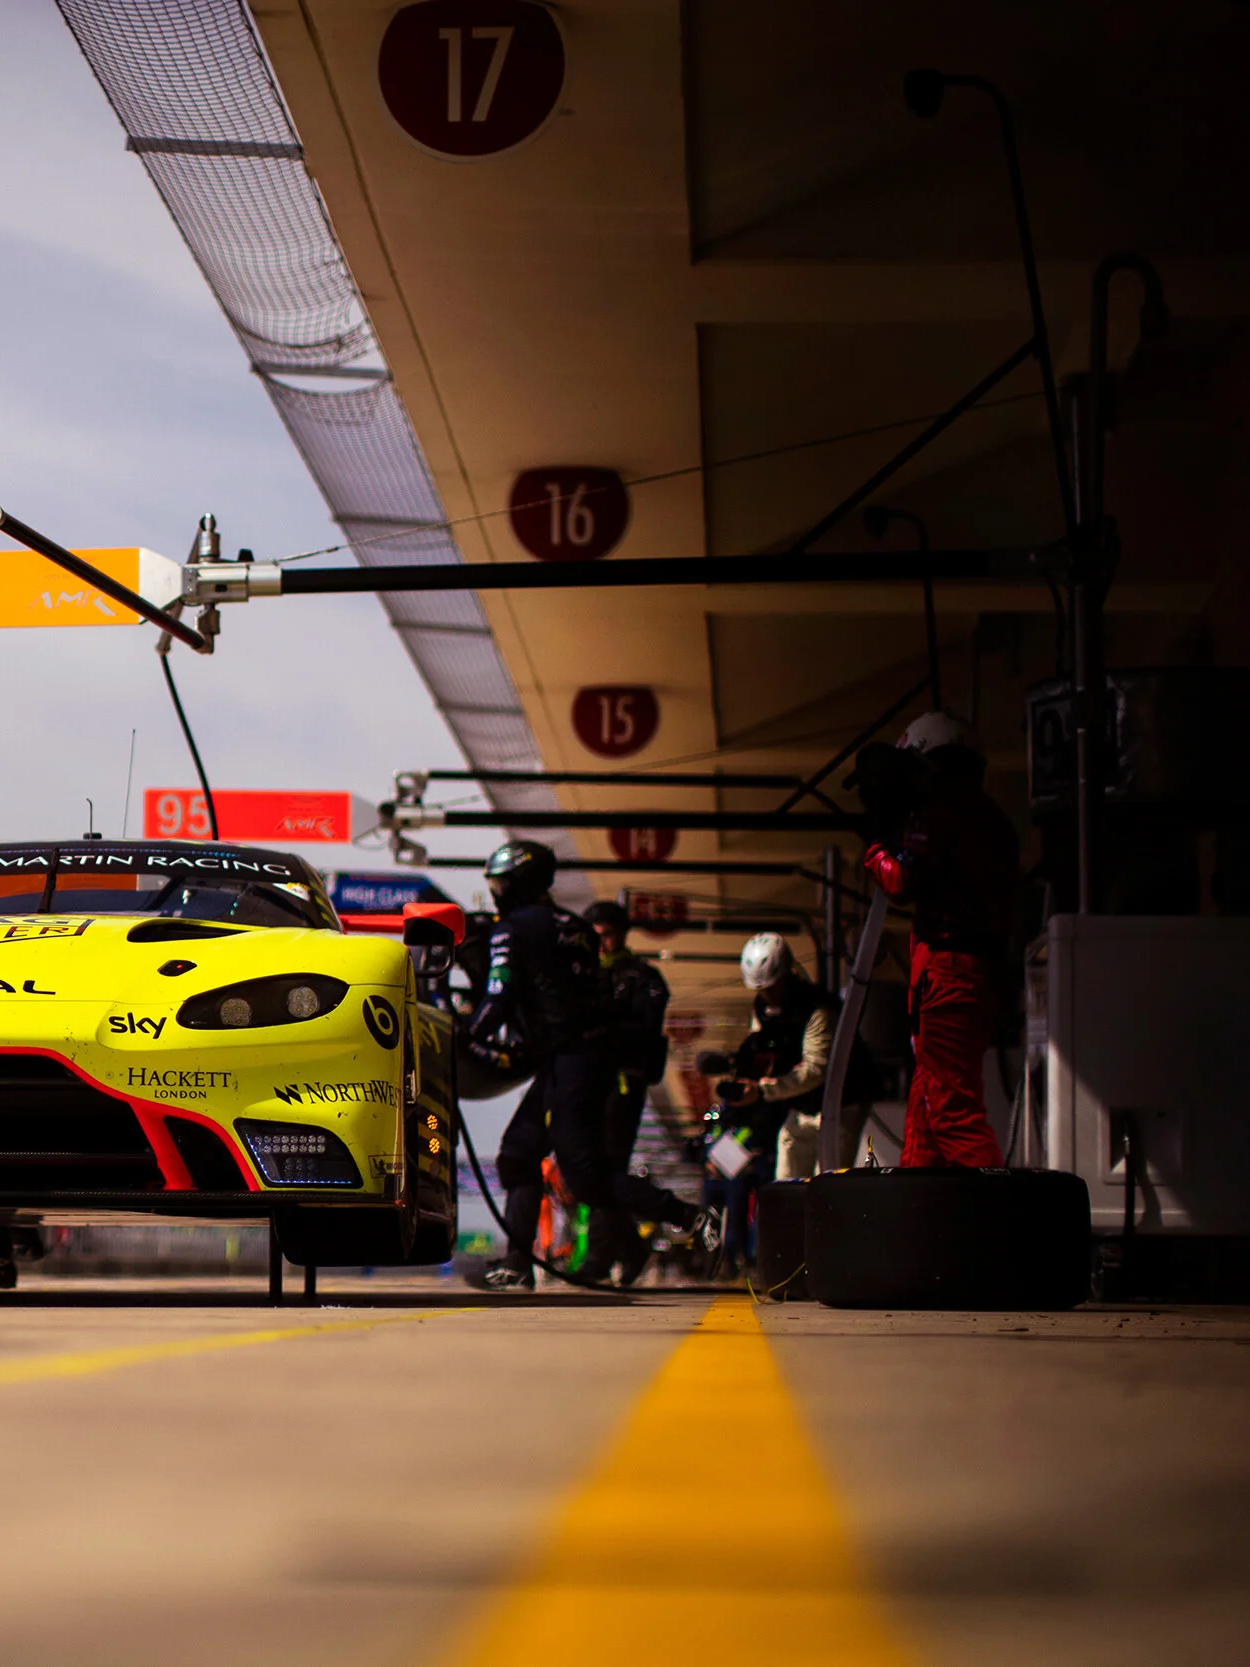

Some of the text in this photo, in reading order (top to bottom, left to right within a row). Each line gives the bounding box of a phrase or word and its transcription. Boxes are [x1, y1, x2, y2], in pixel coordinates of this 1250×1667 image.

[438, 26, 515, 122] 17
[545, 482, 594, 546] 16
[28, 590, 118, 616] AMR
[599, 696, 635, 743] 15
[159, 795, 212, 834] 95
[147, 856, 291, 876] RACING
[109, 1012, 167, 1039] sky
[127, 1067, 231, 1088] HACKETT
[154, 1090, 207, 1099] LONDON
